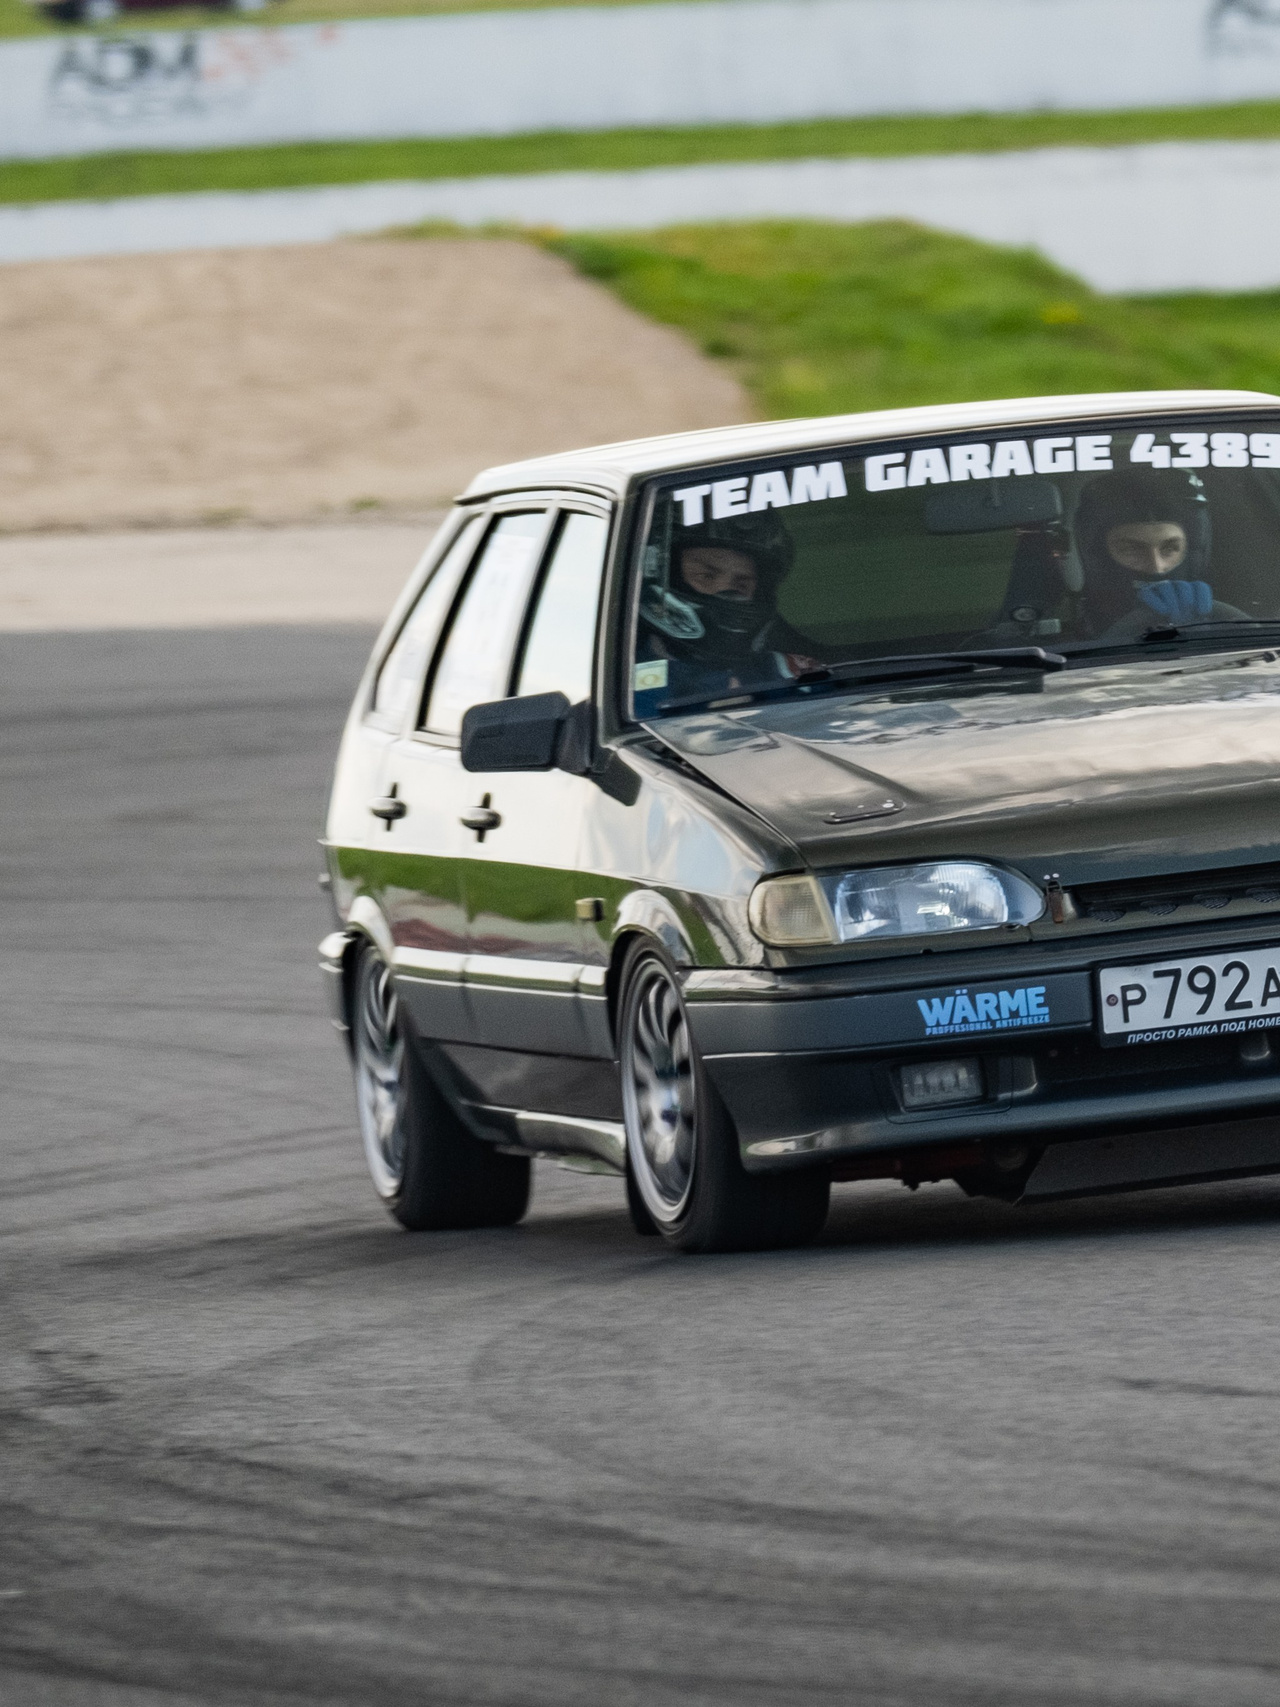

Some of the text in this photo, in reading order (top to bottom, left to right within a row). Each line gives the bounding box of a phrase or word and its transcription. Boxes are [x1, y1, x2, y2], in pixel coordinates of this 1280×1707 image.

[673, 461, 848, 526] TEAM
[865, 435, 1114, 492] GARAGE
[917, 986, 1049, 1027] WÄRME
[996, 1015, 1050, 1028] ANTIFREEZE
[1127, 1029, 1176, 1043] ПРОСТО
[1178, 1023, 1218, 1038] РАМКА
[1220, 1020, 1246, 1033] ПОД
